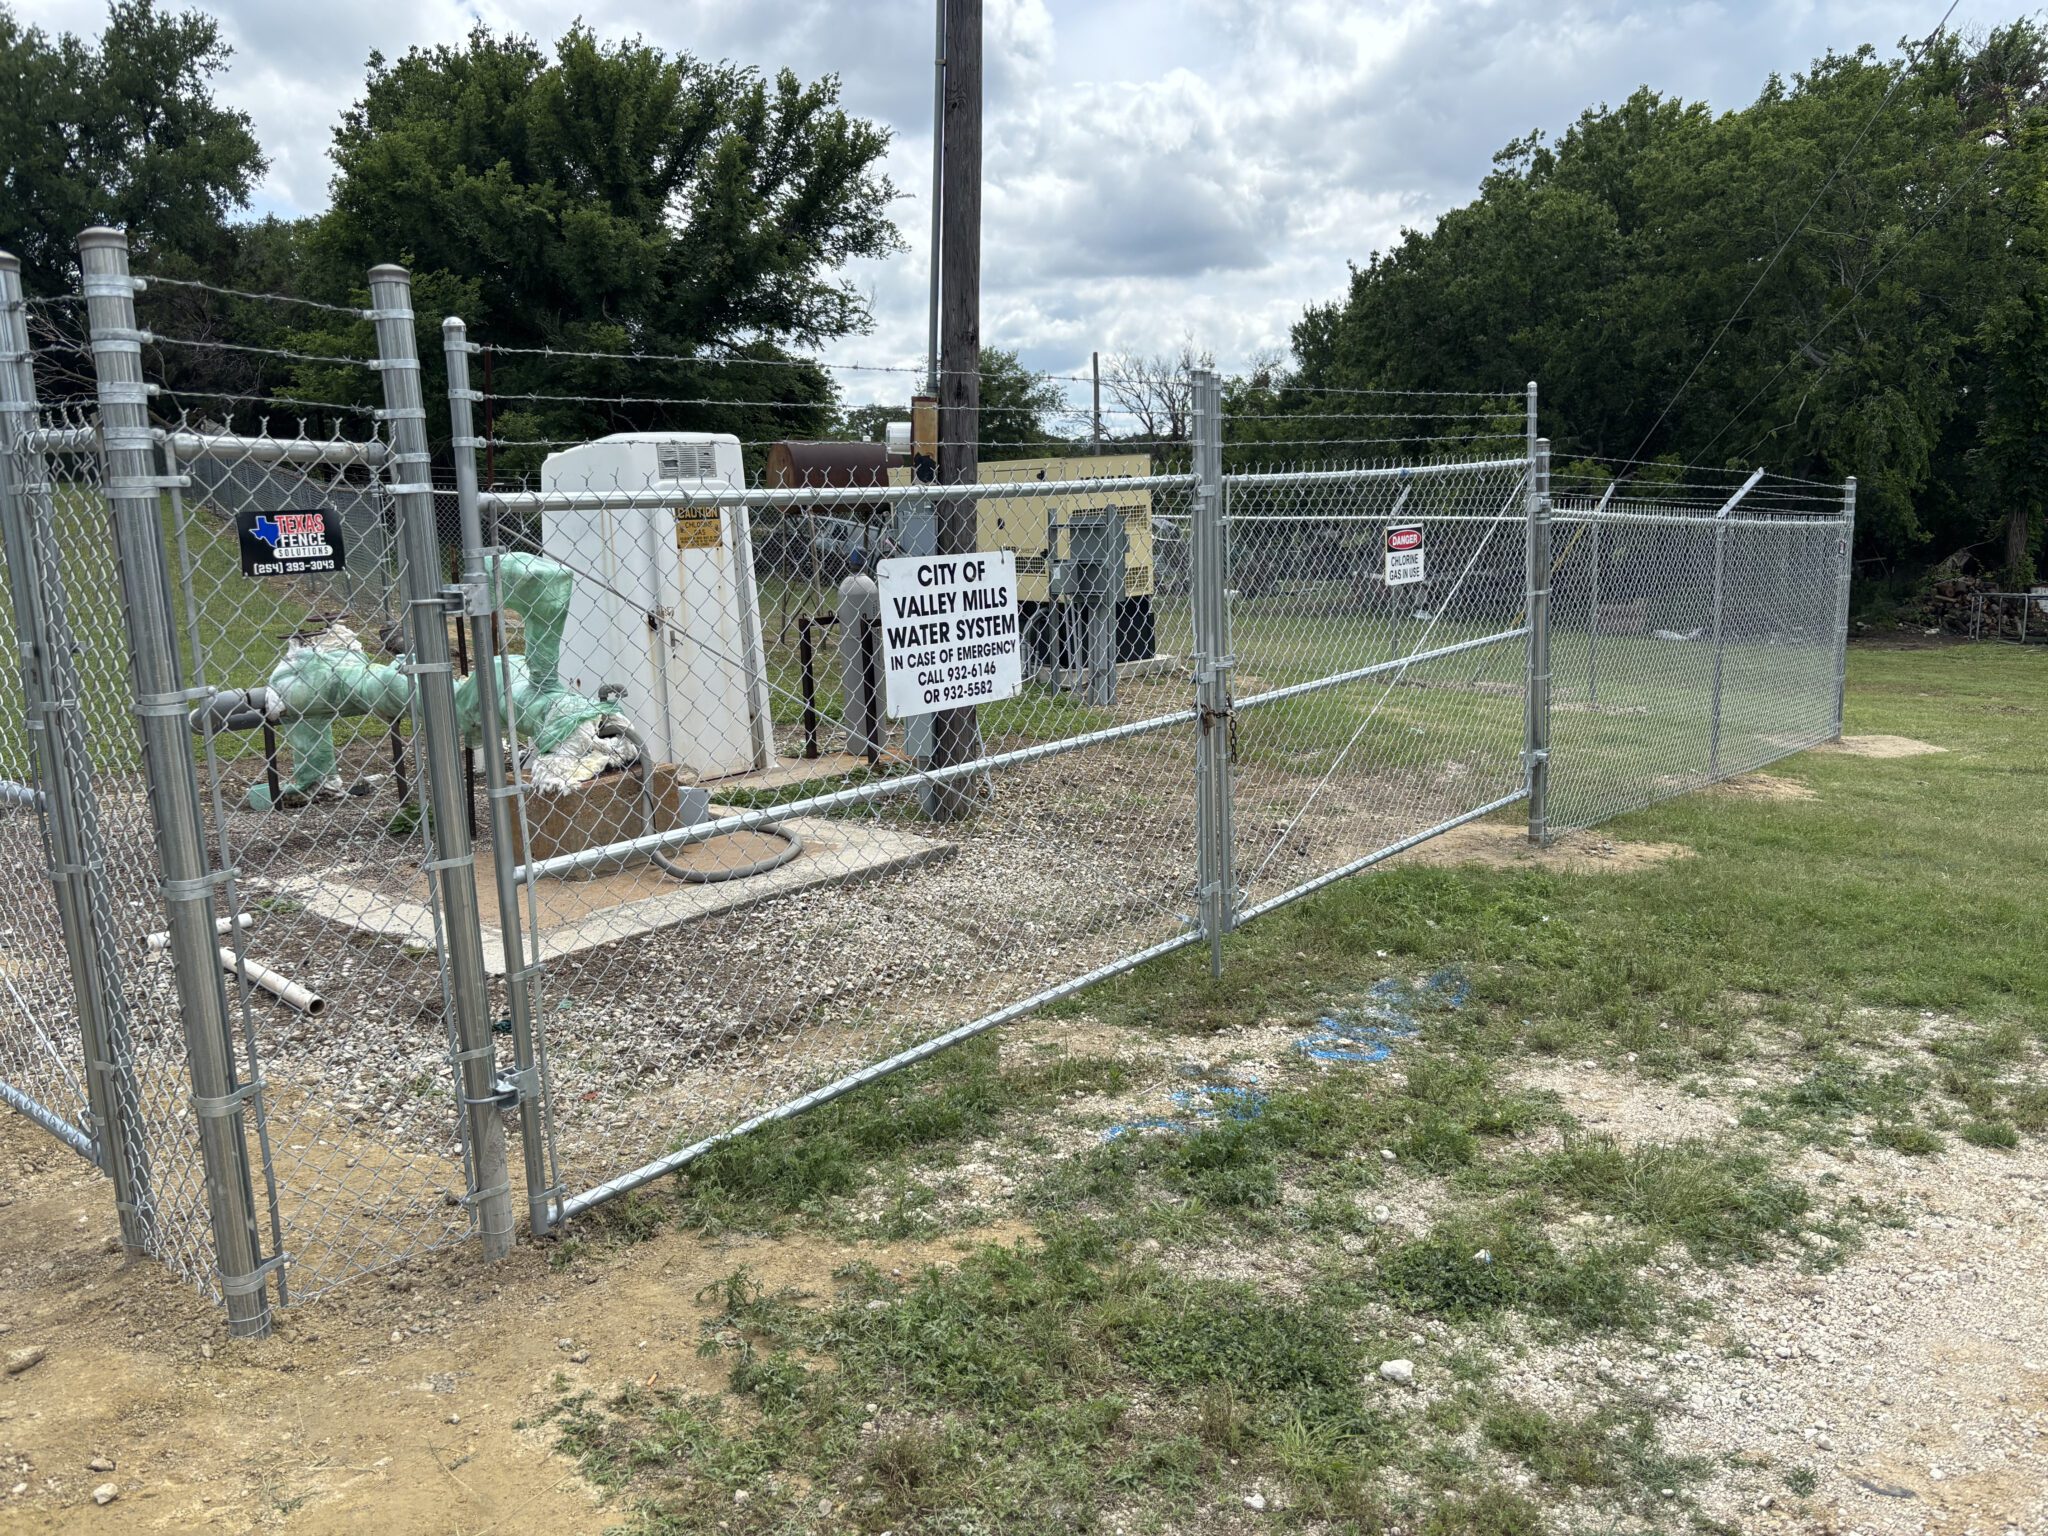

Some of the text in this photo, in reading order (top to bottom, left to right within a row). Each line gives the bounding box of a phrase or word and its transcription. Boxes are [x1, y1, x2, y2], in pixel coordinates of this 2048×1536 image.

[274, 513, 326, 534] TEXAS
[280, 533, 326, 547] FENCE
[1392, 534, 1418, 546] DANGER
[278, 546, 329, 557] SOLUTIONS
[1391, 554, 1419, 567] CHLORINE
[286, 560, 335, 572] 393-3043
[917, 561, 985, 587] CITY OF
[1389, 567, 1420, 581] GAS IN USE
[893, 592, 957, 619] VALLEY
[963, 586, 1008, 611] MILLS
[887, 613, 1015, 649] WATER SYSTEM
[891, 639, 1017, 671] IN CASE OF EMERGENCY
[918, 661, 996, 686] CALL 932-6146
[924, 680, 993, 704] OR 932-5582
